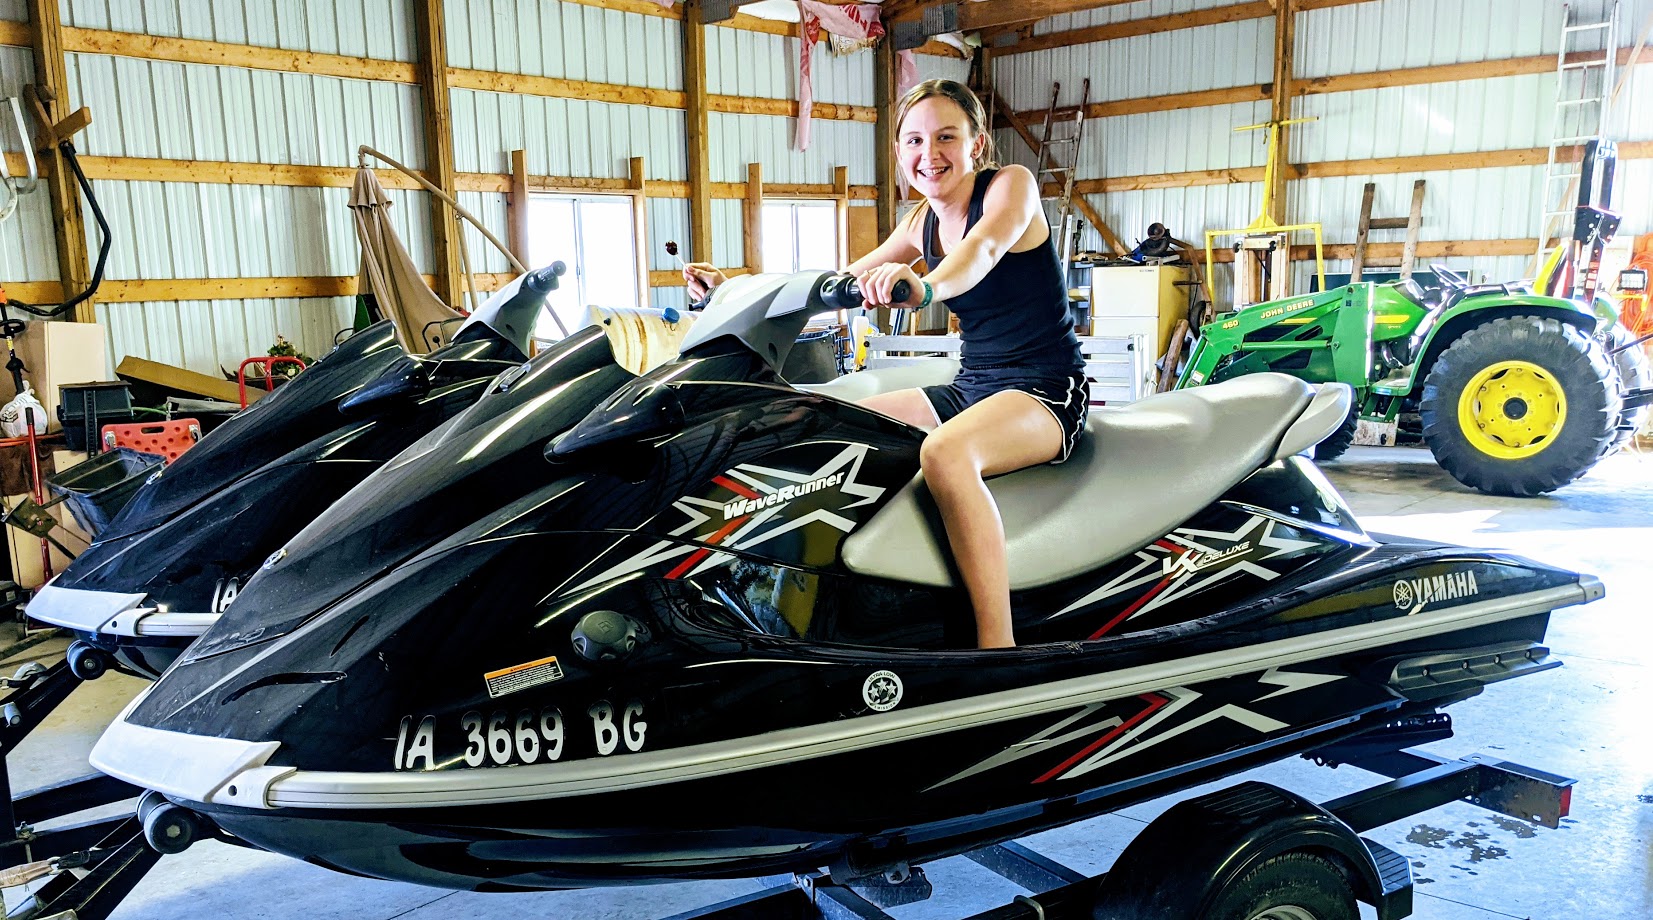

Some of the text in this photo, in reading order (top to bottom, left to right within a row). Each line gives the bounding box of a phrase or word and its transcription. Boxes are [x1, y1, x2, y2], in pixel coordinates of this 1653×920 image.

[1222, 320, 1239, 329] 460
[1261, 299, 1314, 319] JOHN DEERE
[723, 471, 845, 521] WaveRunner
[1162, 541, 1250, 580] VX DELUXE
[211, 577, 239, 613] IA
[1411, 570, 1478, 603] YAMAHA
[883, 671, 896, 679] LOW
[394, 700, 648, 771] IA 3669 BG
